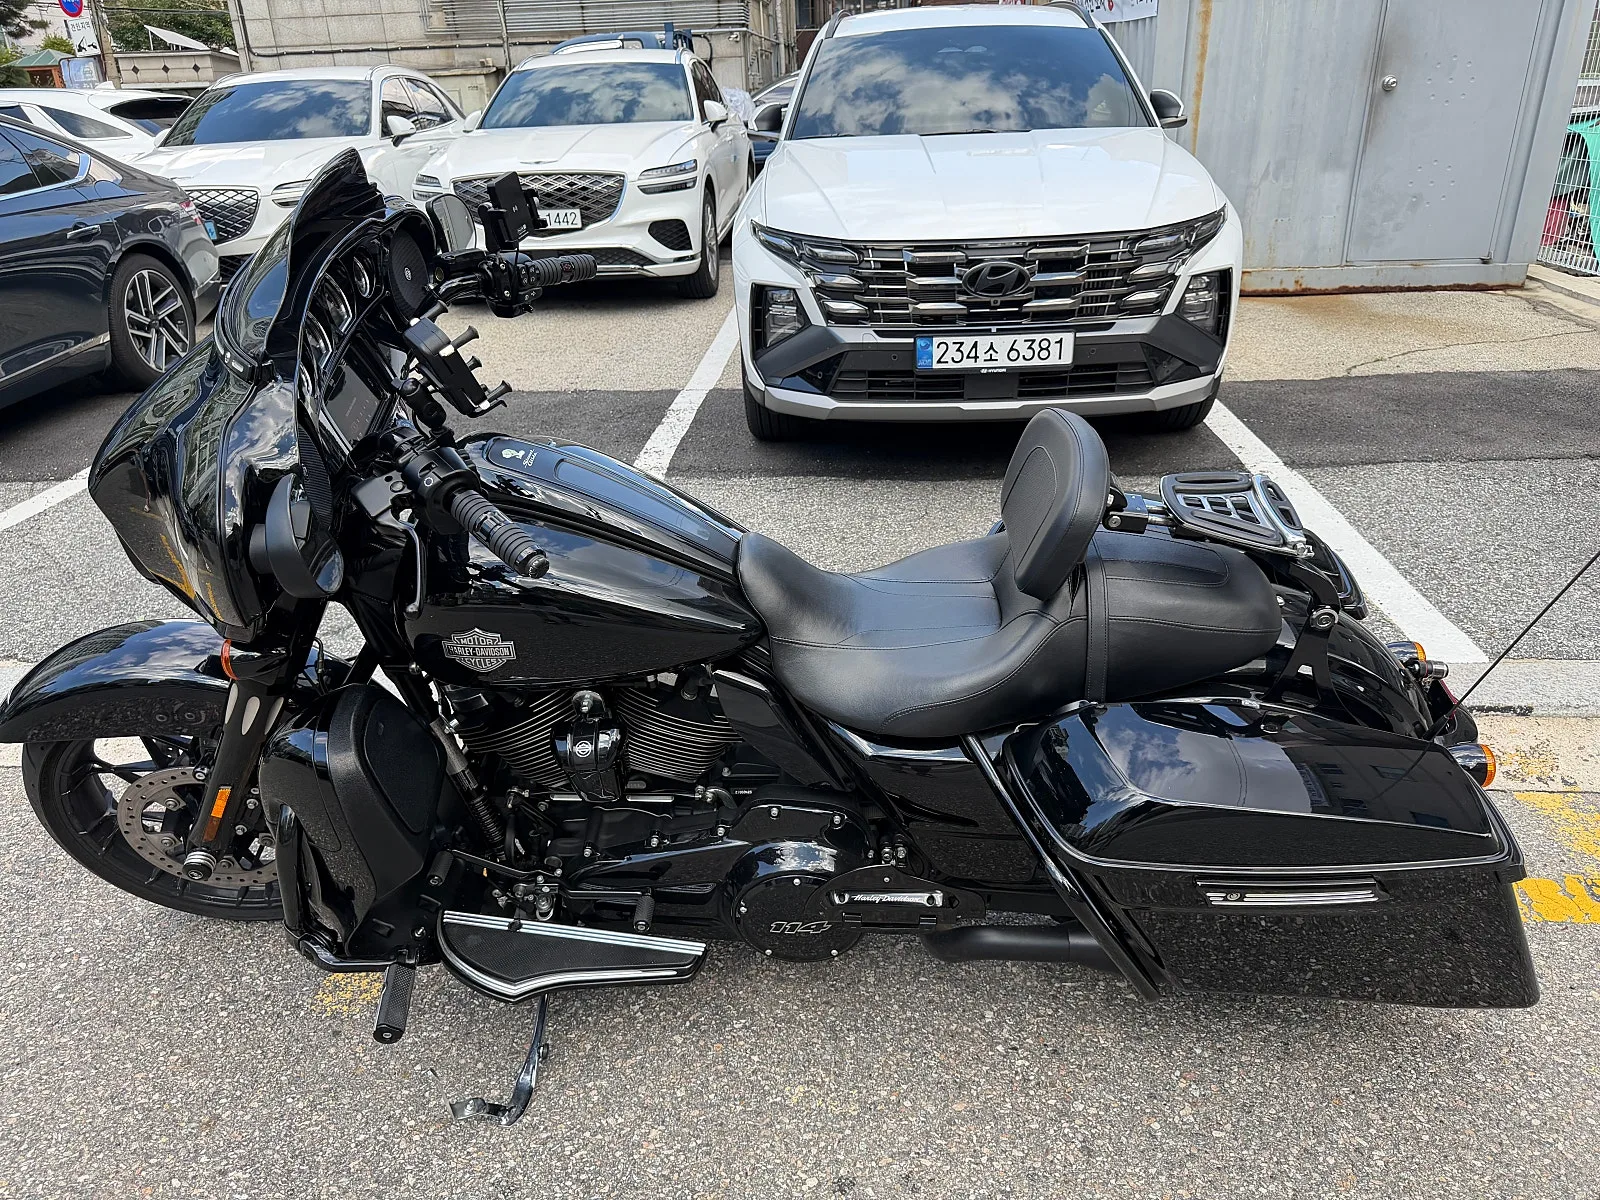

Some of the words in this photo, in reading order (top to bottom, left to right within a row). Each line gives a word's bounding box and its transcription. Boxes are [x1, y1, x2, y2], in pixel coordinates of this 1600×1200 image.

[70, 21, 91, 32] 견인지역
[546, 211, 578, 226] 1442
[936, 340, 999, 364] 234소
[1006, 337, 1064, 362] 6381
[460, 636, 494, 645] MOTOR
[447, 645, 510, 656] HARLEY-DAVIDSON
[770, 921, 832, 934] 114
